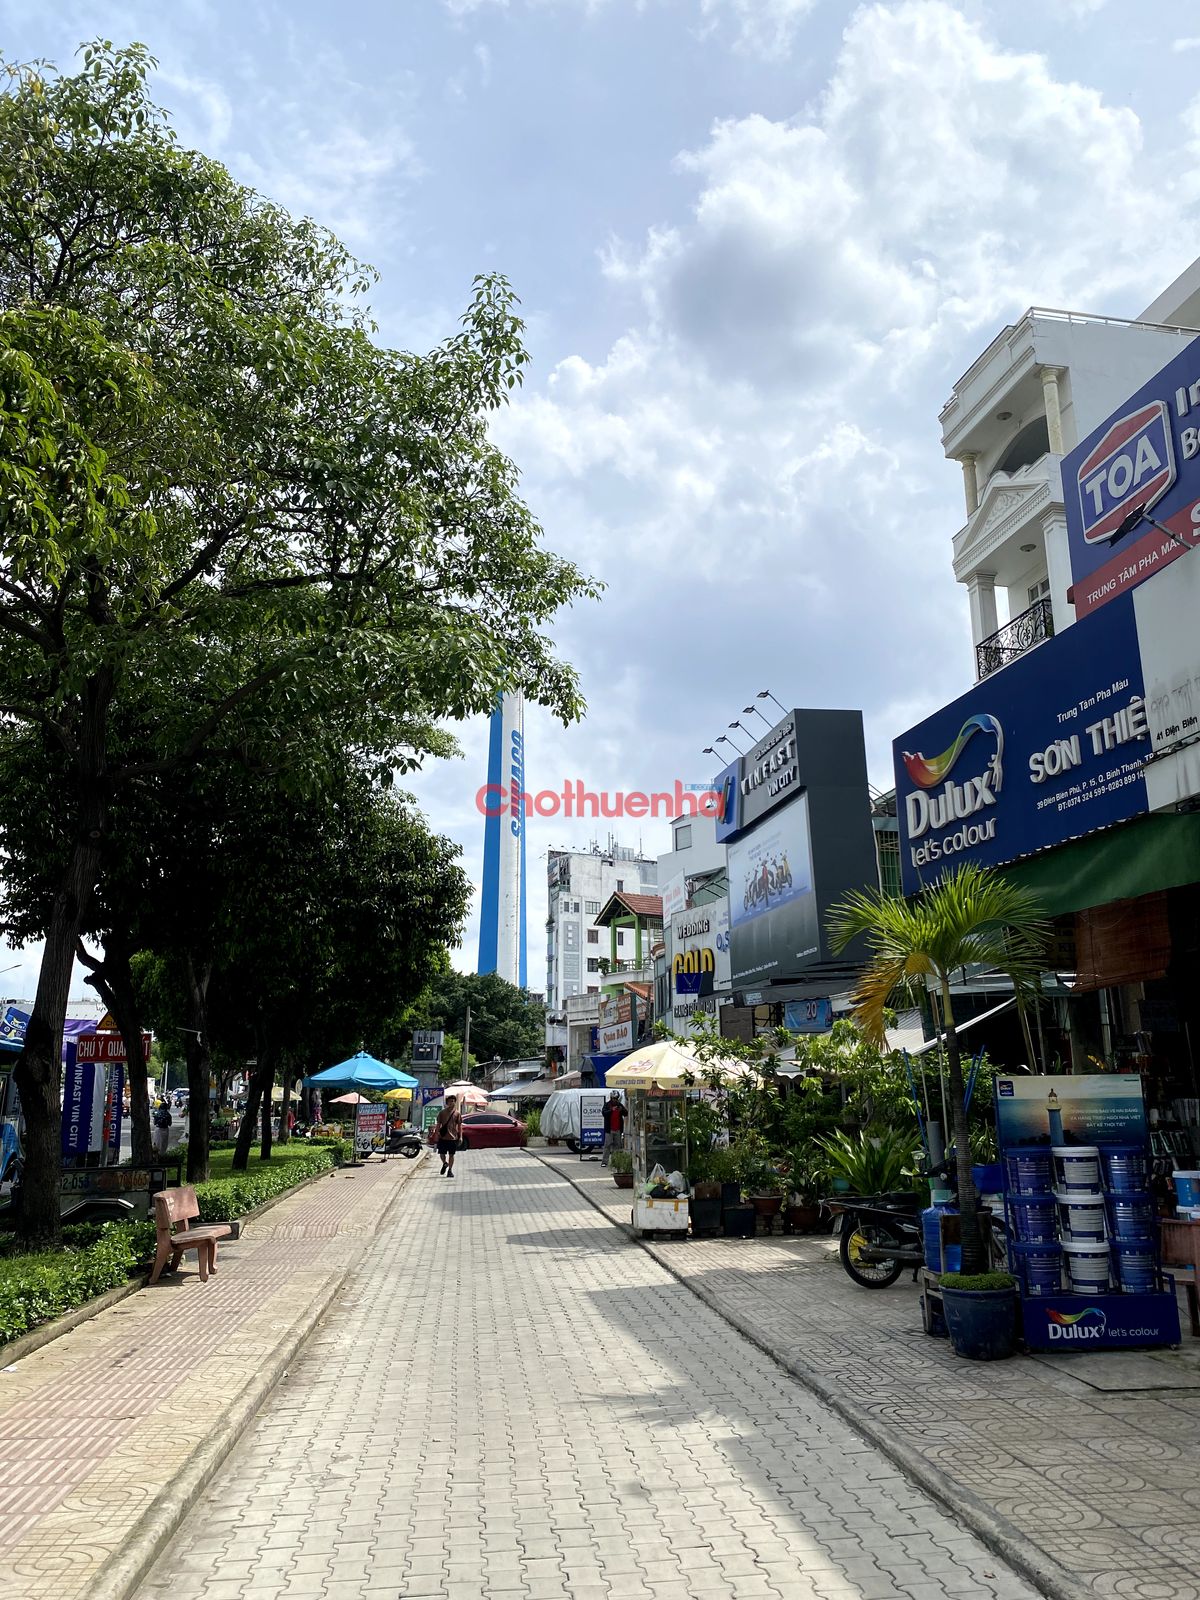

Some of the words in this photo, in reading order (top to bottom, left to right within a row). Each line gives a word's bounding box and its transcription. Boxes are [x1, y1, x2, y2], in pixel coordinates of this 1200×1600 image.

[1085, 434, 1161, 516] TOA
[1087, 578, 1117, 604] TRUNG
[1118, 564, 1137, 583] TÂM
[1138, 551, 1159, 571] PHA
[1056, 706, 1078, 723] Trung
[1096, 687, 1111, 703] Pha
[1111, 677, 1129, 694] Màu
[1156, 731, 1164, 741] 41
[741, 738, 796, 796] VINFAST
[1029, 735, 1082, 784] SƠN
[778, 766, 797, 789] CITY
[1082, 791, 1093, 802] 324
[1124, 774, 1136, 785] 899
[905, 770, 997, 839] Dulux
[911, 838, 942, 868] let's
[943, 817, 996, 855] colour
[677, 919, 710, 940] WEDDING
[78, 1037, 96, 1057] CHÚ
[98, 1037, 104, 1057] Ý
[72, 1063, 84, 1102] VINFAST
[71, 1104, 80, 1122] VIN
[69, 1125, 78, 1148] CITY
[109, 1123, 117, 1143] CITY
[1048, 1323, 1100, 1340] Dulux
[1108, 1328, 1127, 1337] let's
[1129, 1327, 1160, 1337] colour
